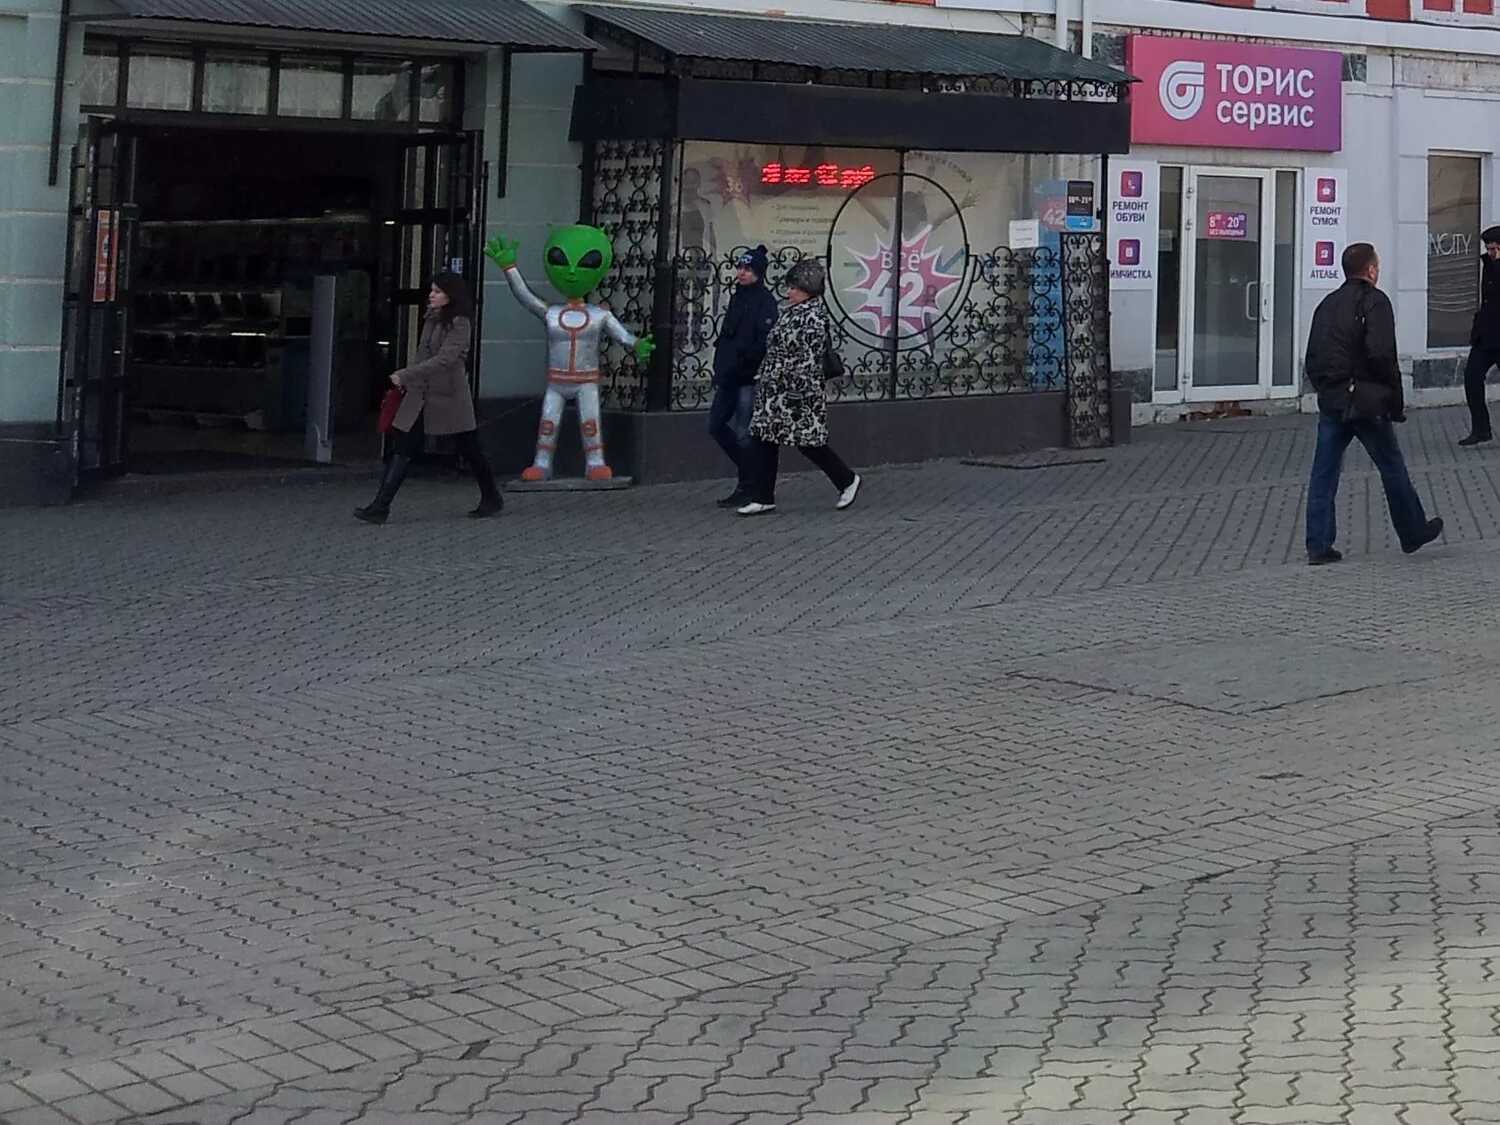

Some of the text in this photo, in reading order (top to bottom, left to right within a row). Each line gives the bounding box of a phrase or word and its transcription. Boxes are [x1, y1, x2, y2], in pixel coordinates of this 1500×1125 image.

[1216, 63, 1315, 99] ТОРИС
[1216, 100, 1314, 131] сервис
[1112, 201, 1149, 211] РЕМОНТ
[1310, 206, 1341, 216] РЕМОНТ
[1043, 208, 1066, 226] 42
[1115, 213, 1145, 222] ОБУВИ
[1311, 216, 1339, 225] СУМОК
[1429, 232, 1472, 255] NCITY
[1110, 270, 1153, 279] ИМЧИСТКА
[1310, 269, 1339, 279] АТЕЛЬЕ
[866, 269, 924, 317] 42
